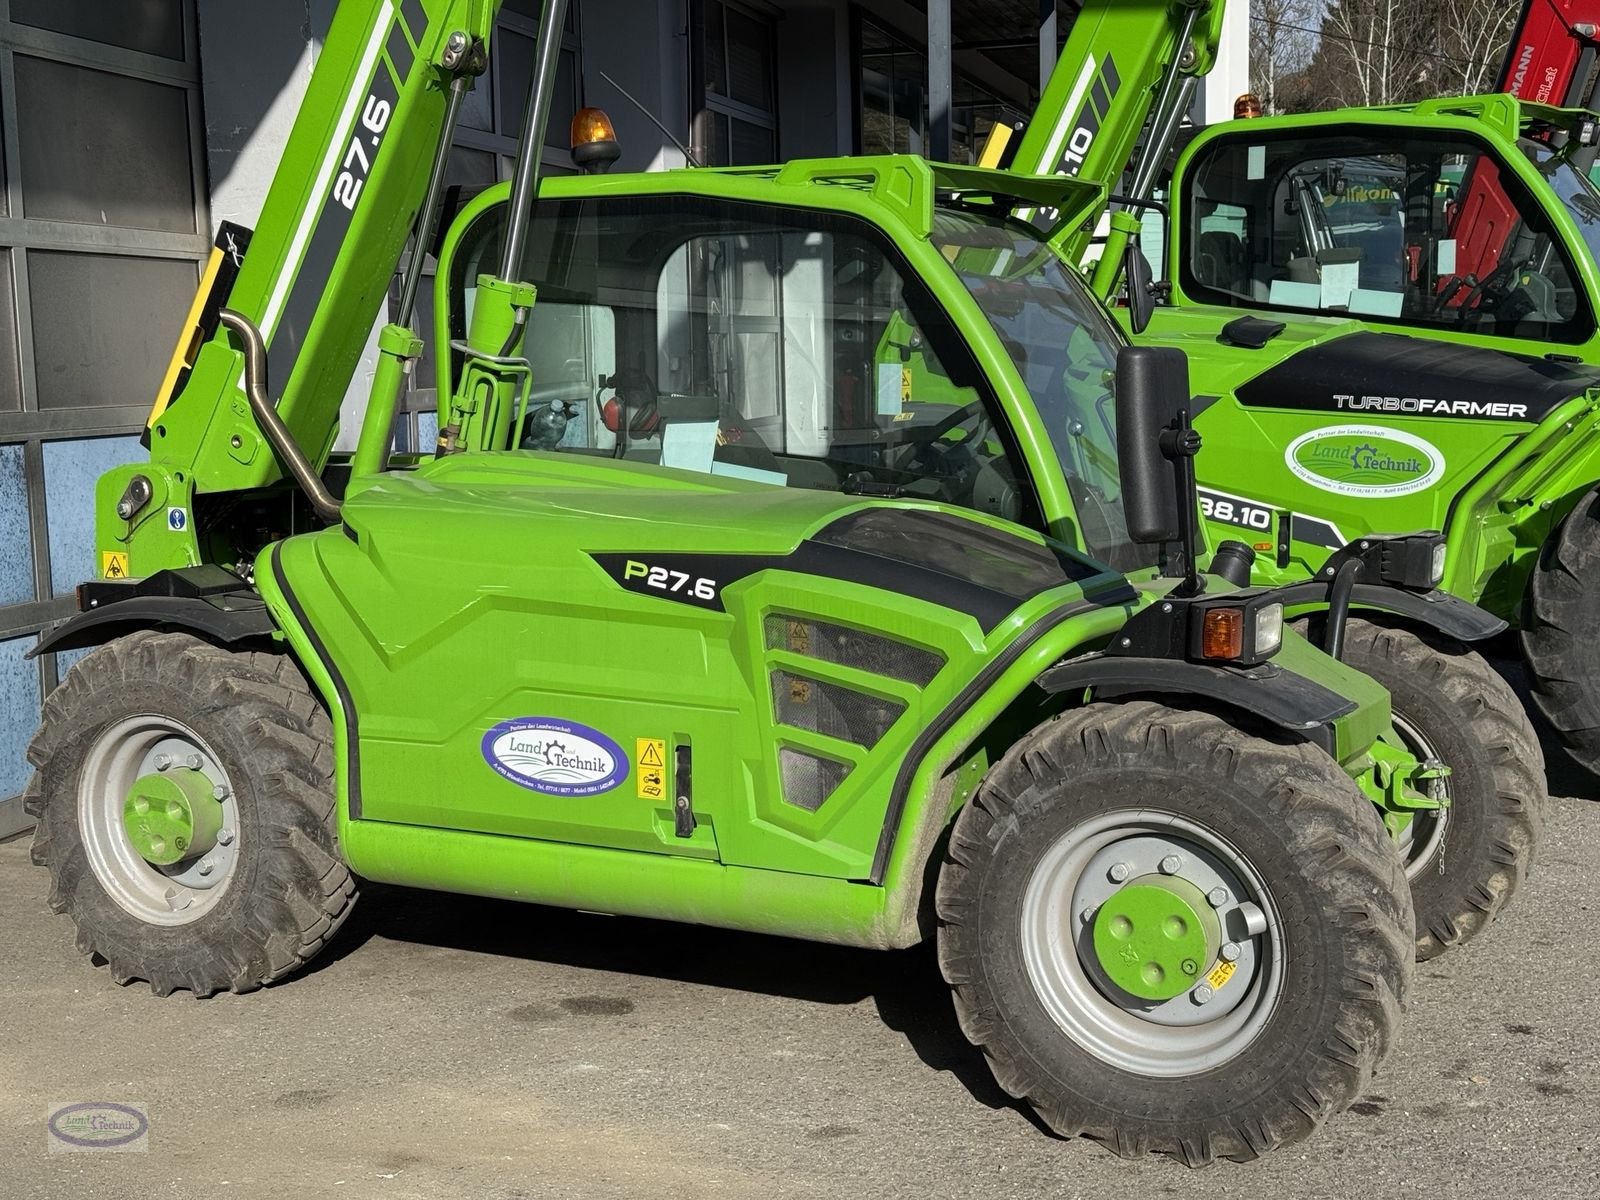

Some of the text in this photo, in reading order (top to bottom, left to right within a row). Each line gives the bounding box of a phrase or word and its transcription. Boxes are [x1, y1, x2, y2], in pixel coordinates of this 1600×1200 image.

[333, 94, 391, 211] 27.6
[1333, 394, 1528, 418] TURBOFARMER
[1312, 443, 1351, 459] Land
[1363, 455, 1422, 473] Technik
[1200, 497, 1271, 529] 38.10
[624, 559, 716, 600] P27.6
[509, 737, 543, 755] Land
[554, 753, 606, 773] Technik
